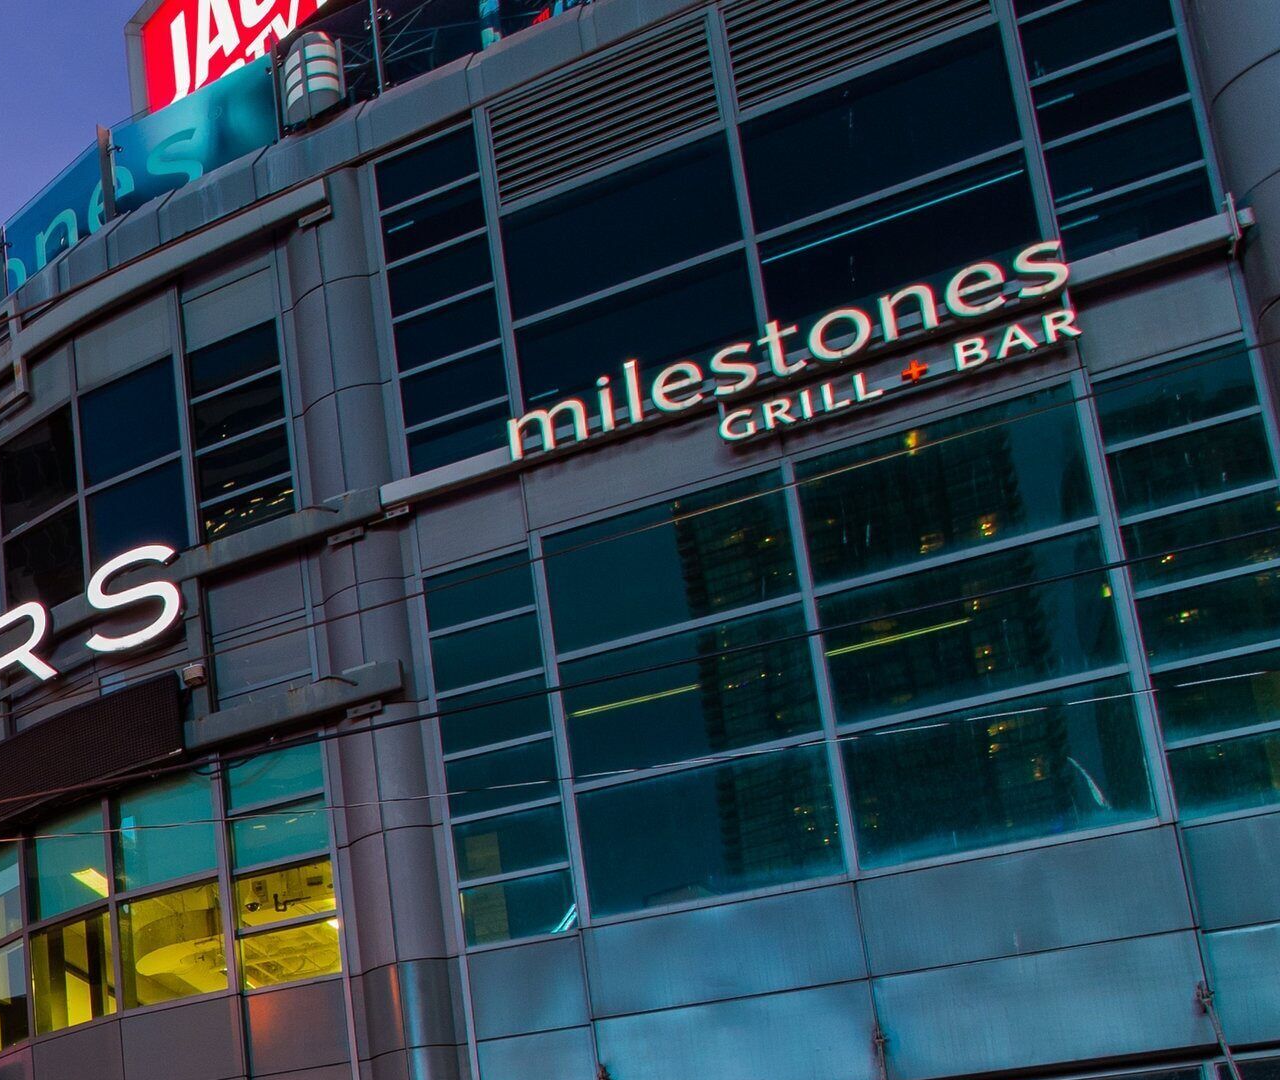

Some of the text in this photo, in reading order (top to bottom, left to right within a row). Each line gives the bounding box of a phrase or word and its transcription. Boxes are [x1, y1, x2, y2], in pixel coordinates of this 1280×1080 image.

[507, 240, 1070, 462] milestones
[718, 371, 884, 442] GRILL
[953, 309, 1083, 372] BAR
